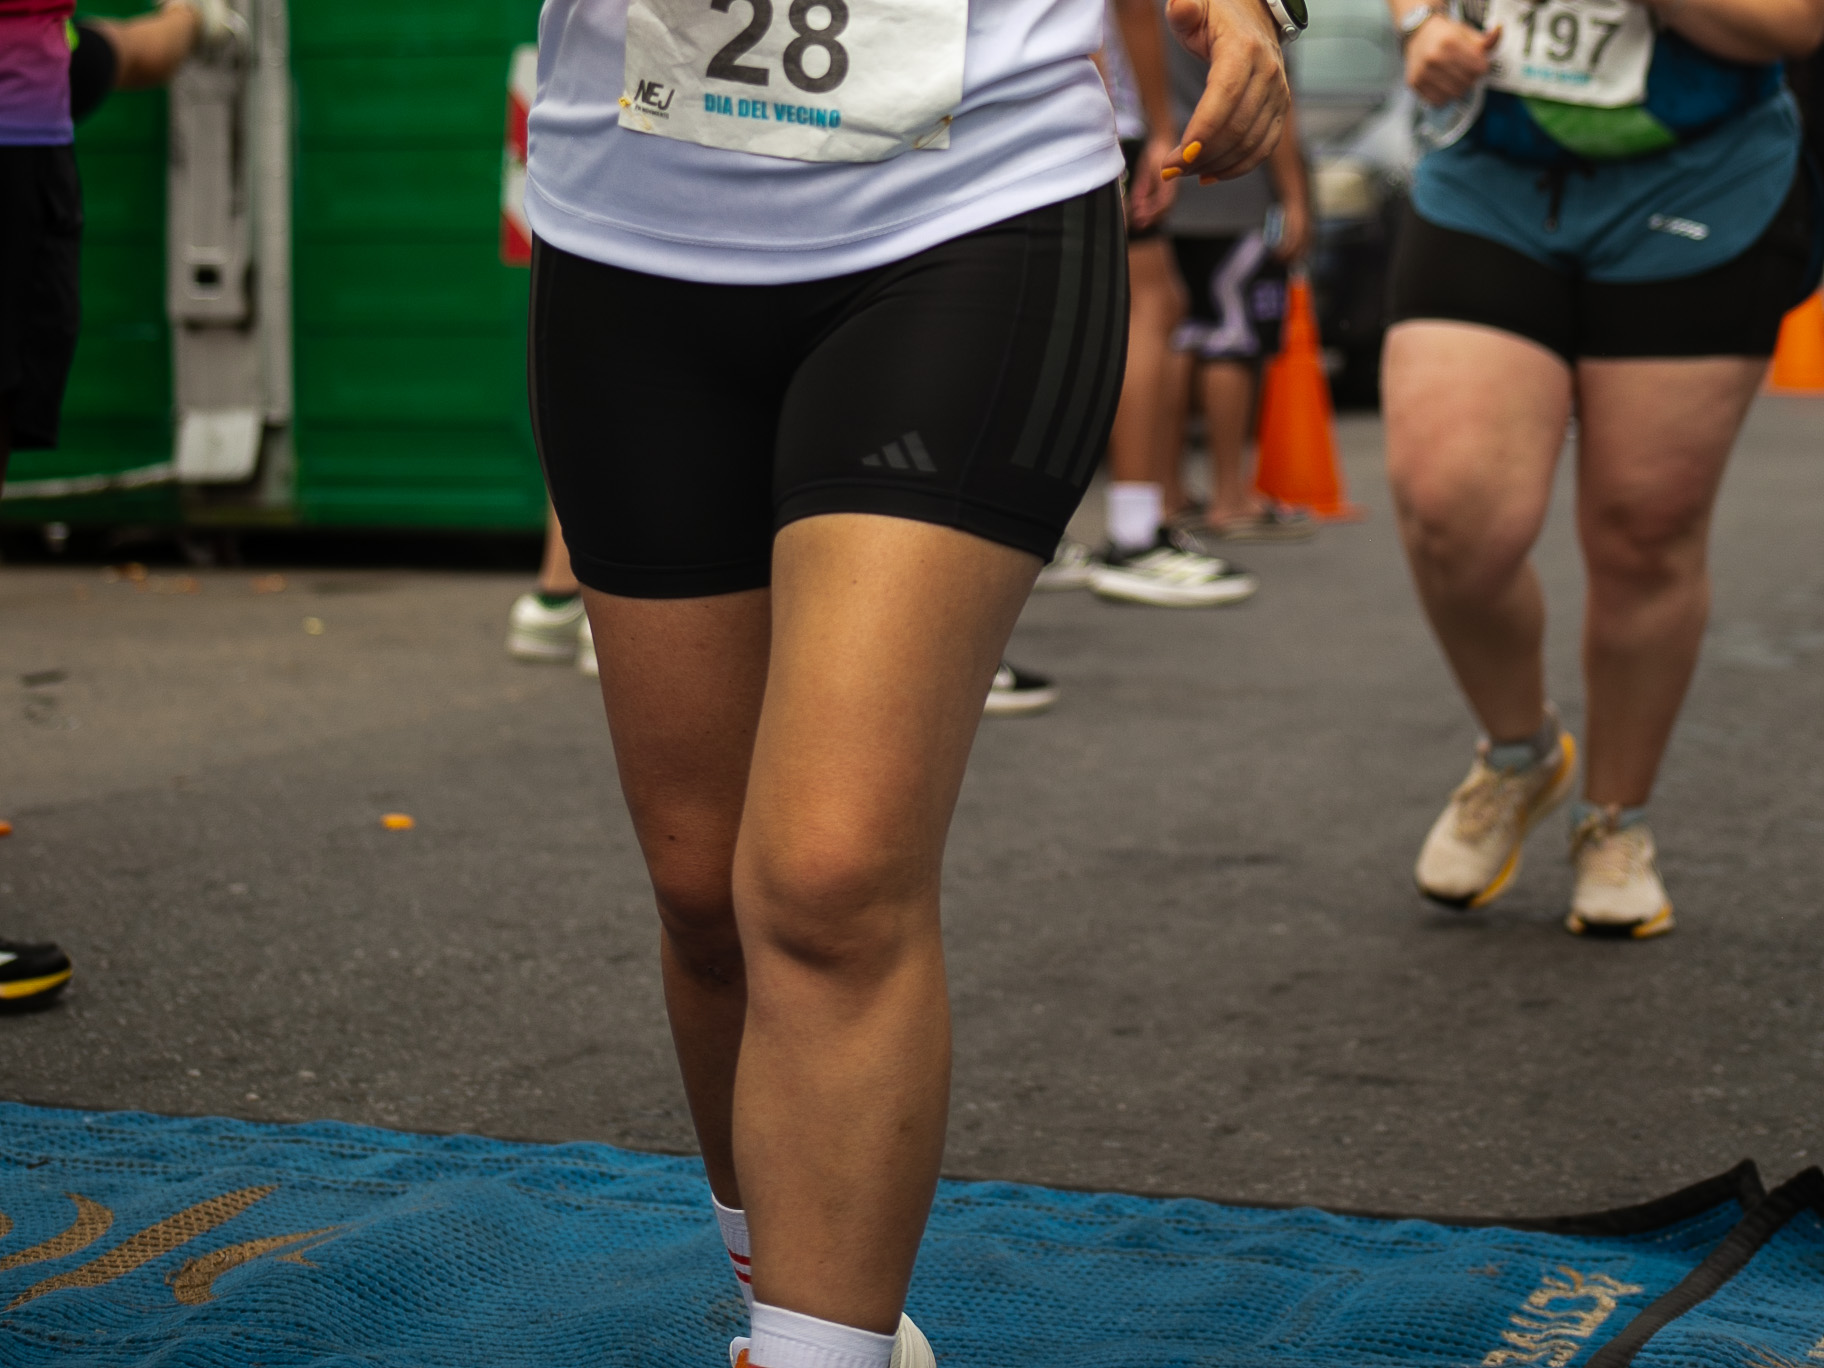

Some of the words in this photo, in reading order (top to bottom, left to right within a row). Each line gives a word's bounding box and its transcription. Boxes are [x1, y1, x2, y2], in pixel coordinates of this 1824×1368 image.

[1519, 6, 1622, 70] 197
[634, 79, 676, 111] NEJ
[704, 92, 736, 117] DIA
[738, 96, 769, 122] DEL
[773, 101, 842, 129] VECINO
